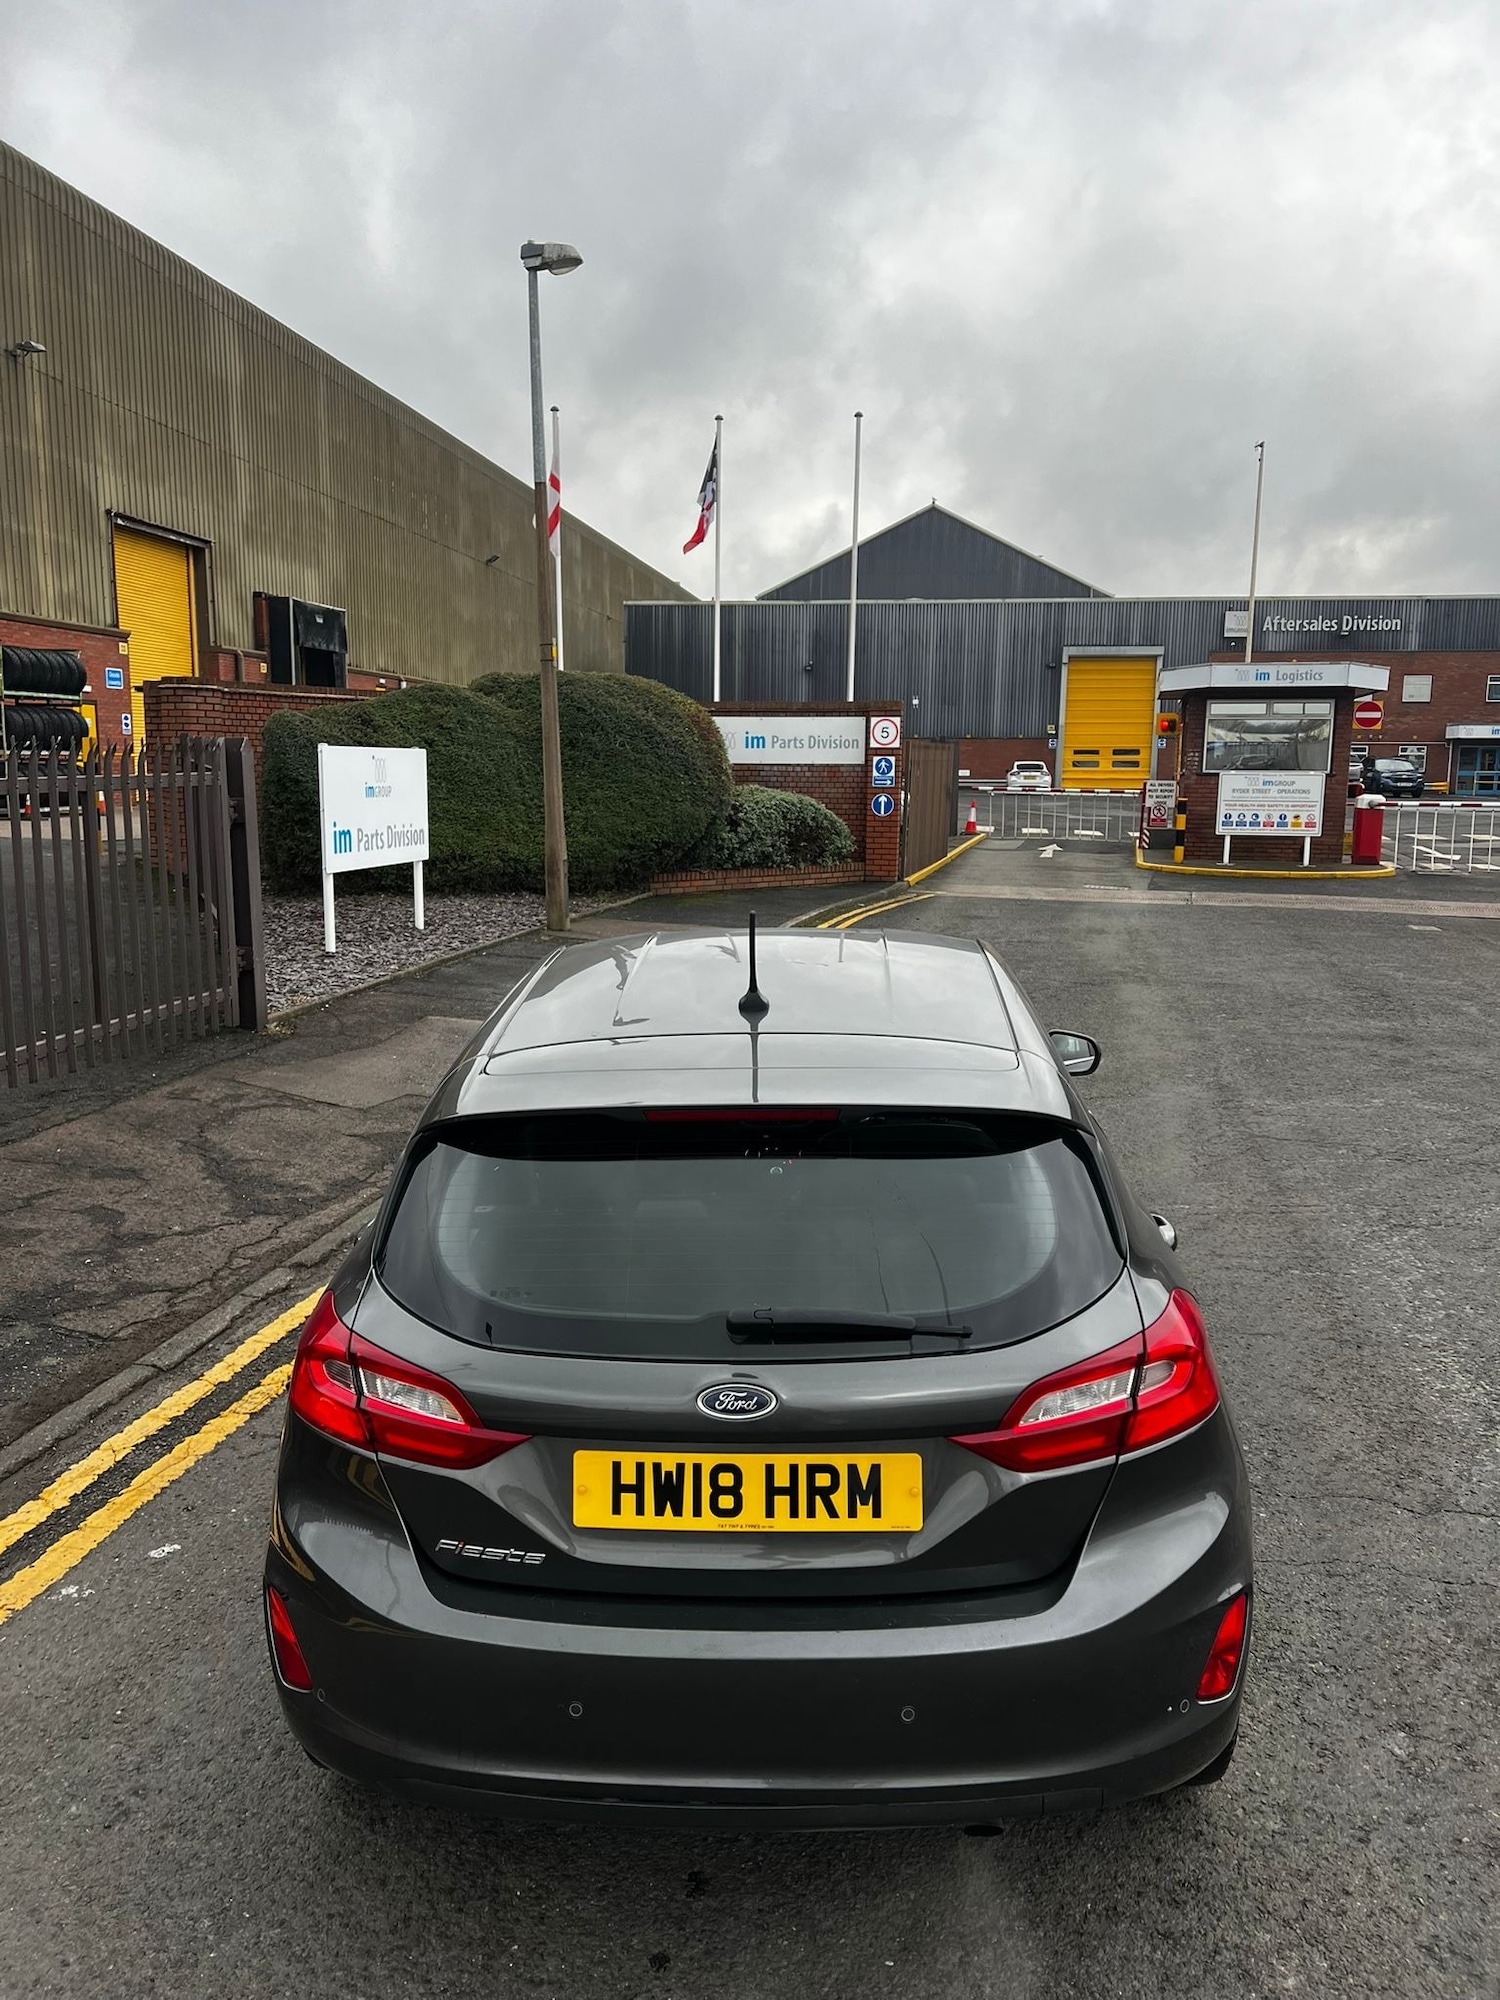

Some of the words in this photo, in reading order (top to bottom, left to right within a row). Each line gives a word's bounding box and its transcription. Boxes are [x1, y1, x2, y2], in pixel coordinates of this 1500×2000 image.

[1262, 615, 1338, 631] Aftersales
[1342, 615, 1402, 631] Division
[1255, 669, 1270, 681] im
[1276, 669, 1324, 683] Logistics
[744, 731, 766, 749] im
[771, 735, 804, 749] Parts
[808, 735, 859, 749] Division
[881, 727, 890, 739] 5
[1262, 779, 1296, 787] imGROUP
[333, 821, 352, 855] im
[357, 827, 385, 853] Parts
[387, 823, 425, 849] Division
[715, 1391, 758, 1411] Ford
[611, 1460, 744, 1519] HW18
[764, 1462, 882, 1519] HRM
[434, 1539, 547, 1564] Fiesta
